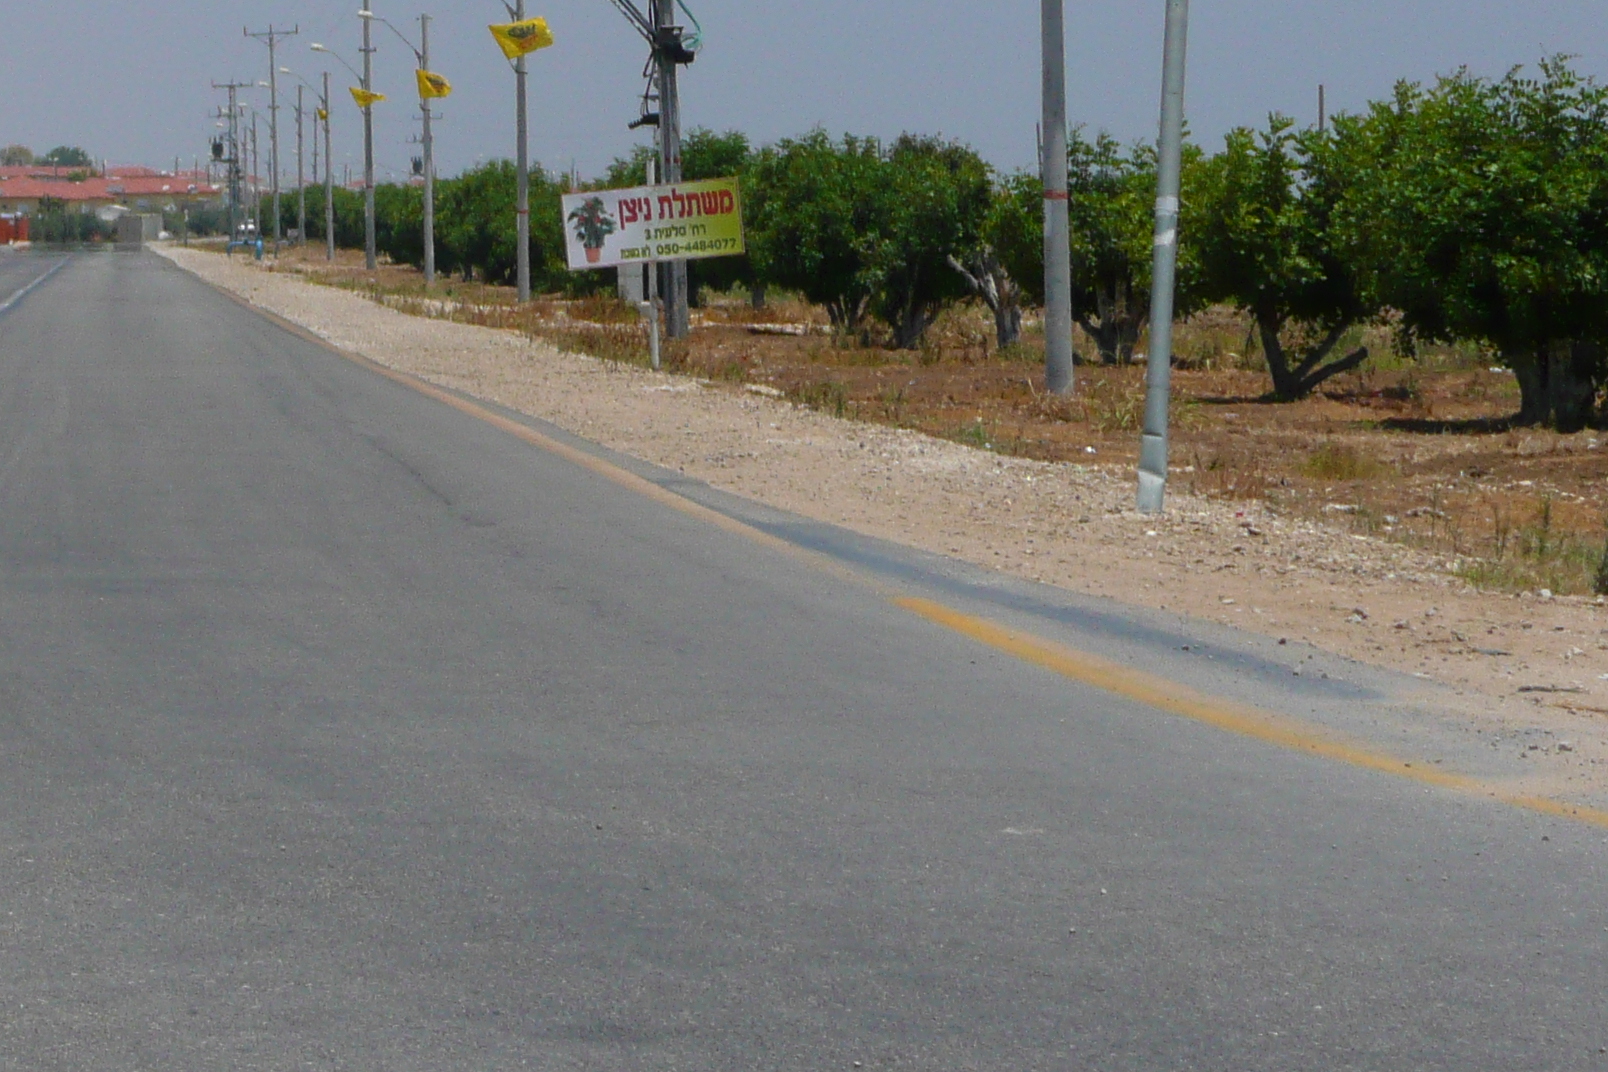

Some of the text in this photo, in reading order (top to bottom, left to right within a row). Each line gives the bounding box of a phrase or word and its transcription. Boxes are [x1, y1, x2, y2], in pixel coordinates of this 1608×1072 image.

[618, 188, 734, 229] משתלת ניצן
[656, 238, 736, 255] 050-4484077
